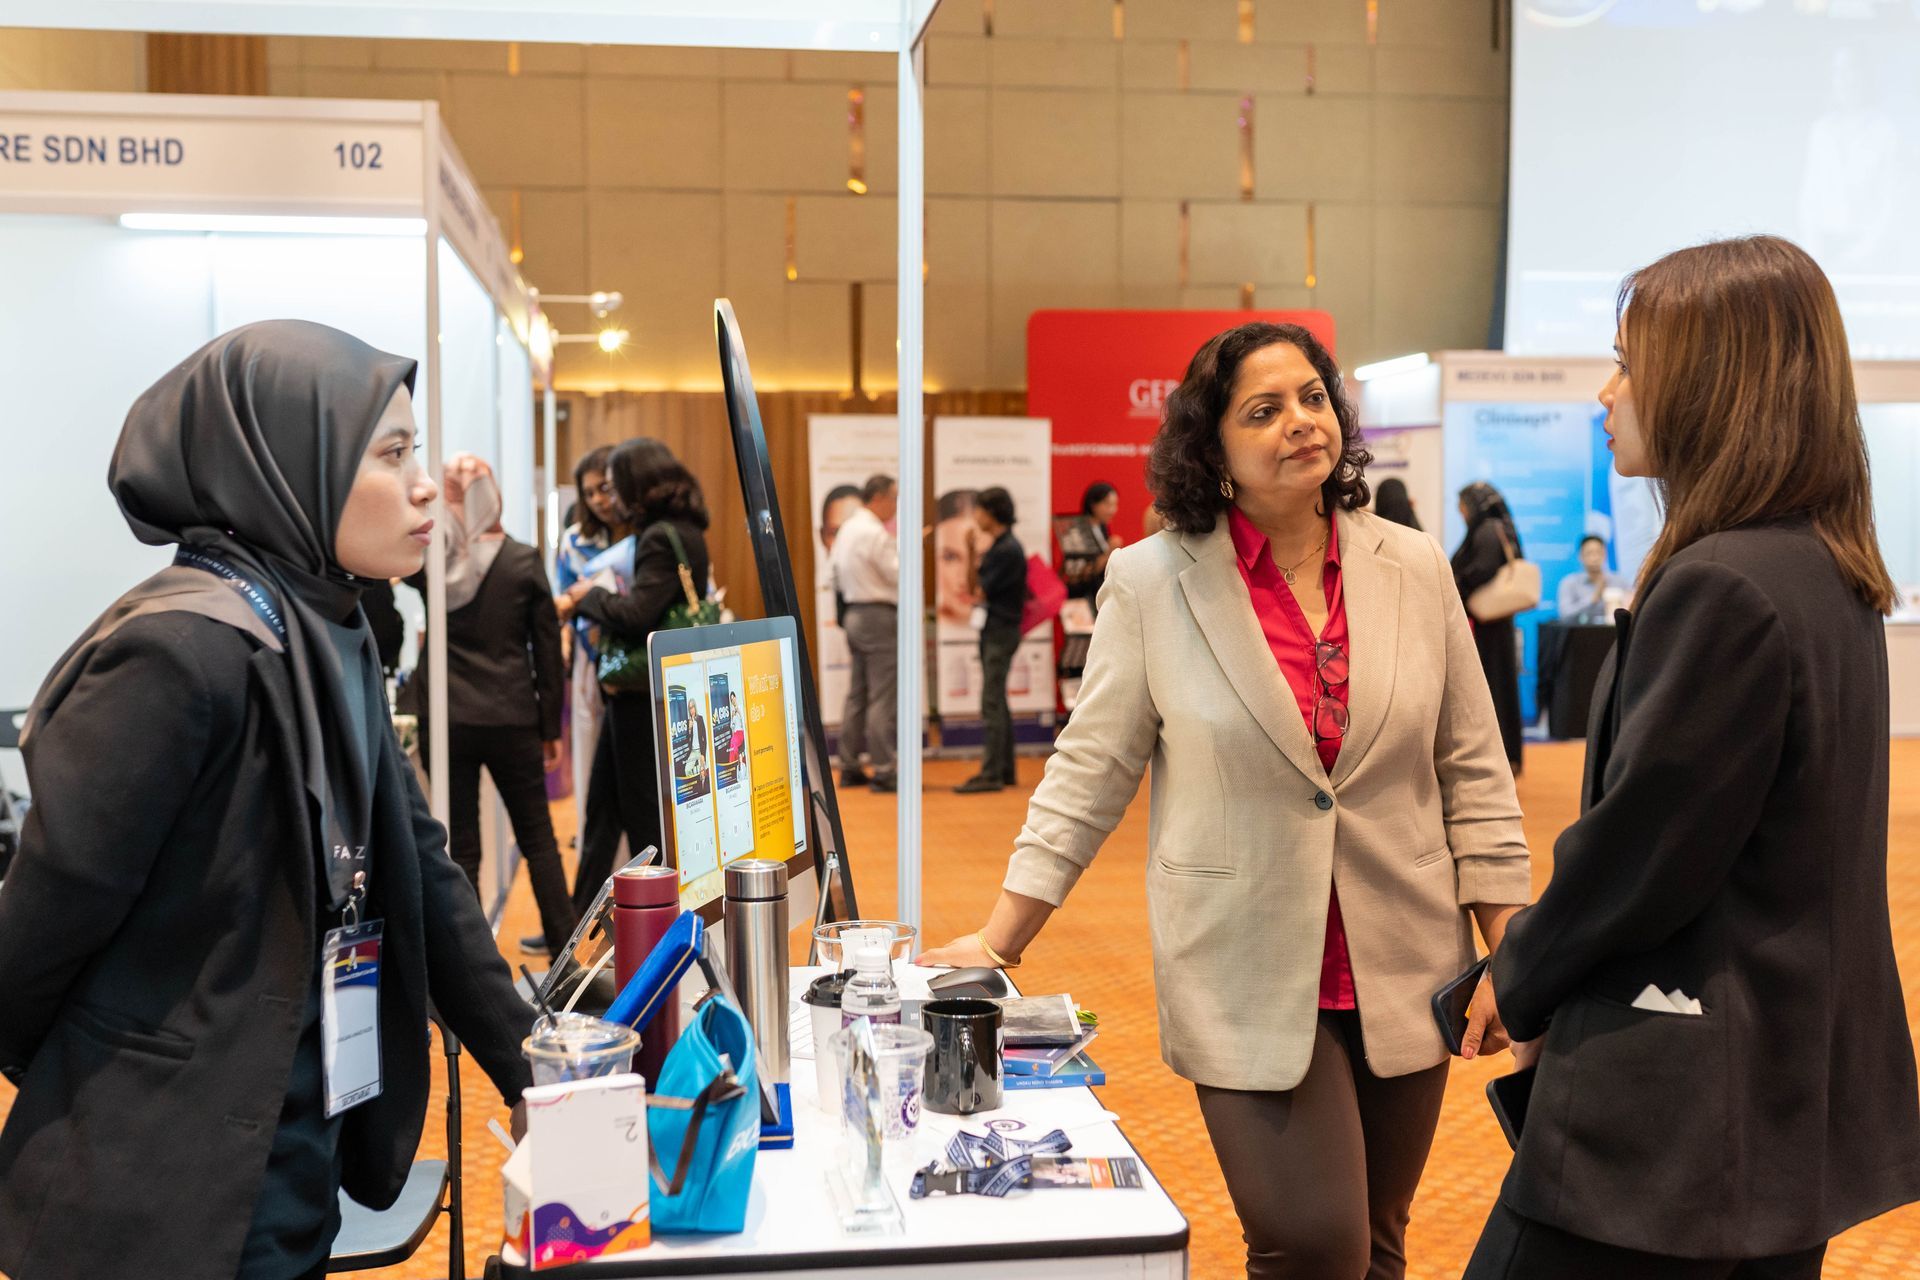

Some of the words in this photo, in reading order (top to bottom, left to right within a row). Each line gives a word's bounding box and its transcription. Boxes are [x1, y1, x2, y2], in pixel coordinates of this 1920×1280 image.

[43, 136, 107, 164] SDN
[119, 138, 185, 166] BHD
[334, 142, 383, 170] 102
